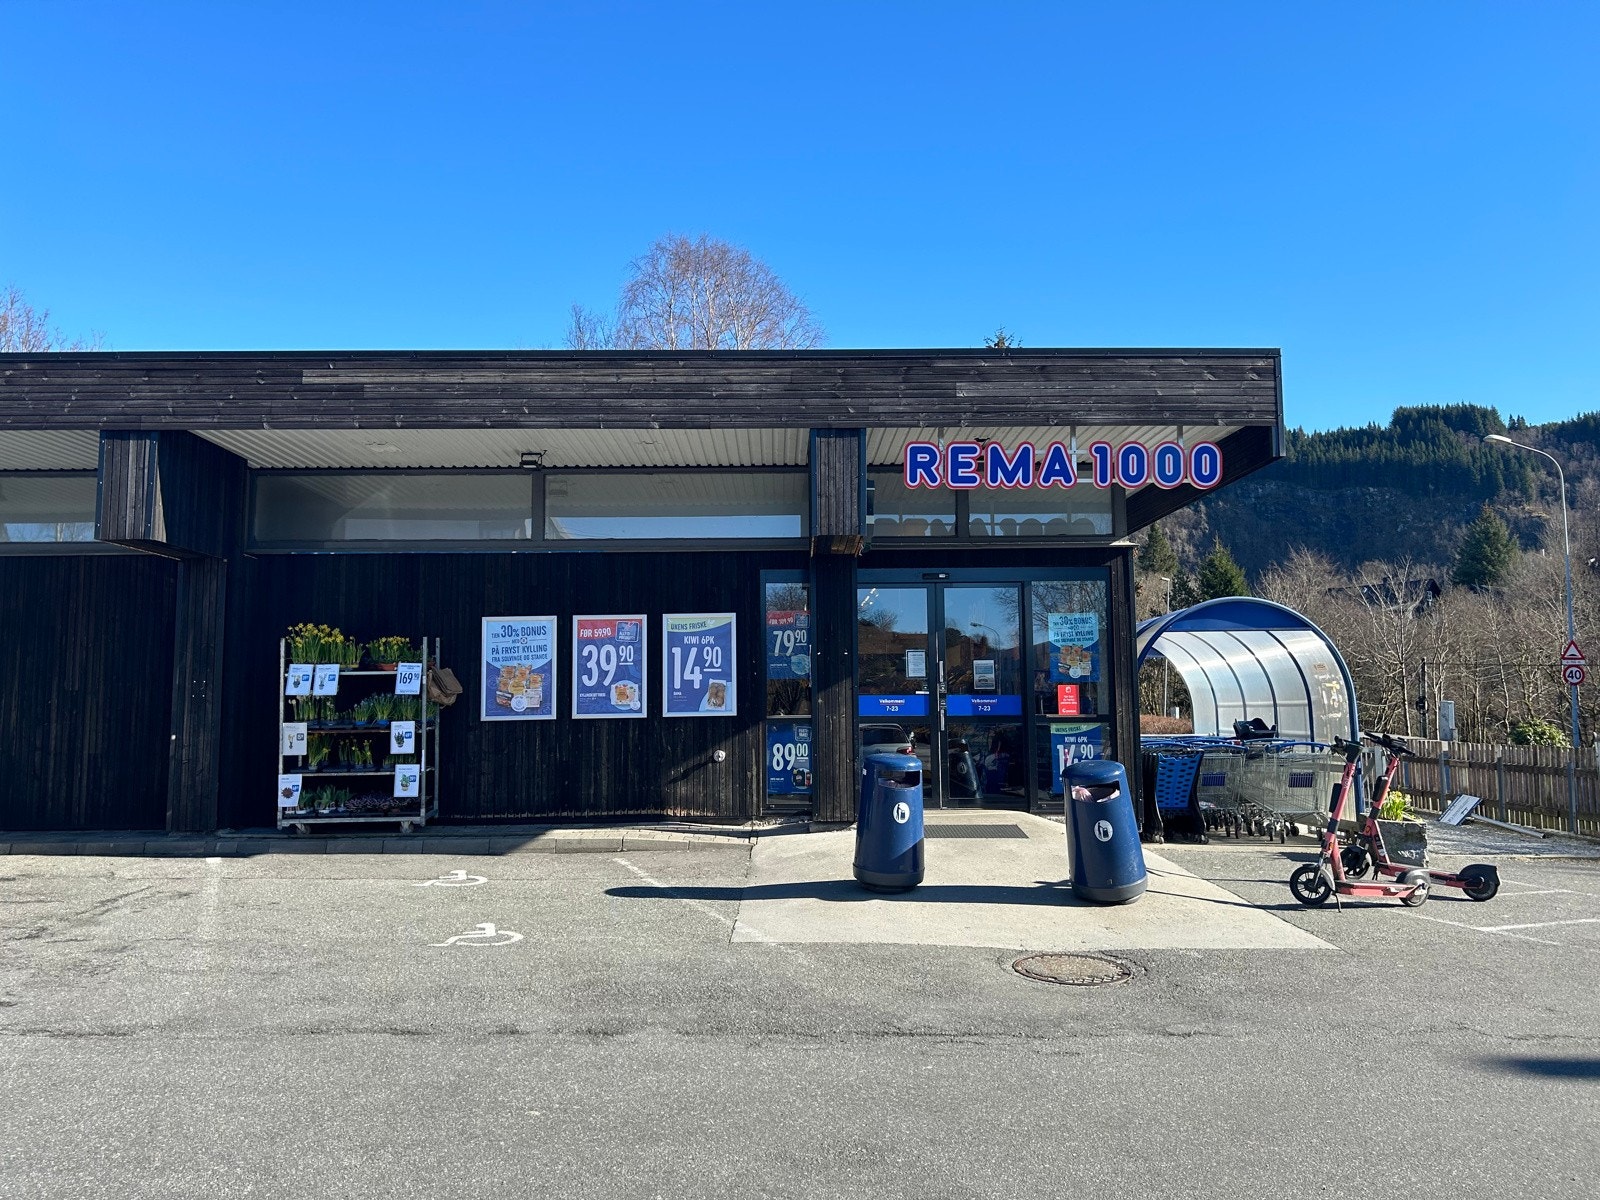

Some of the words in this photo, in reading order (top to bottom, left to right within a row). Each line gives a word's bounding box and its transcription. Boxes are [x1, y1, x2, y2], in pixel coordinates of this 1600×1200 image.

[904, 440, 1077, 489] REMA
[1089, 440, 1223, 489] 1000
[689, 621, 707, 629] FRISKE
[1059, 616, 1073, 626] 30%
[1074, 616, 1093, 625] BONUS
[500, 624, 519, 638] 30%
[521, 626, 547, 636] BONUS
[580, 628, 592, 637] FØR
[594, 627, 612, 637] 59,90
[684, 636, 699, 644] KIWI
[701, 636, 715, 644] 6PK
[773, 630, 794, 656] 79
[795, 629, 806, 643] 90
[492, 645, 499, 655] PÅ
[501, 646, 520, 654] FRYST
[522, 644, 548, 653] KYLLING
[582, 644, 617, 687] 39
[619, 645, 634, 662] 90
[672, 647, 703, 689] 14
[703, 646, 722, 668] 90
[399, 673, 413, 684] 169
[1568, 670, 1581, 680] 40
[772, 743, 795, 771] 89
[796, 743, 808, 757] 00
[1080, 744, 1094, 759] 90
